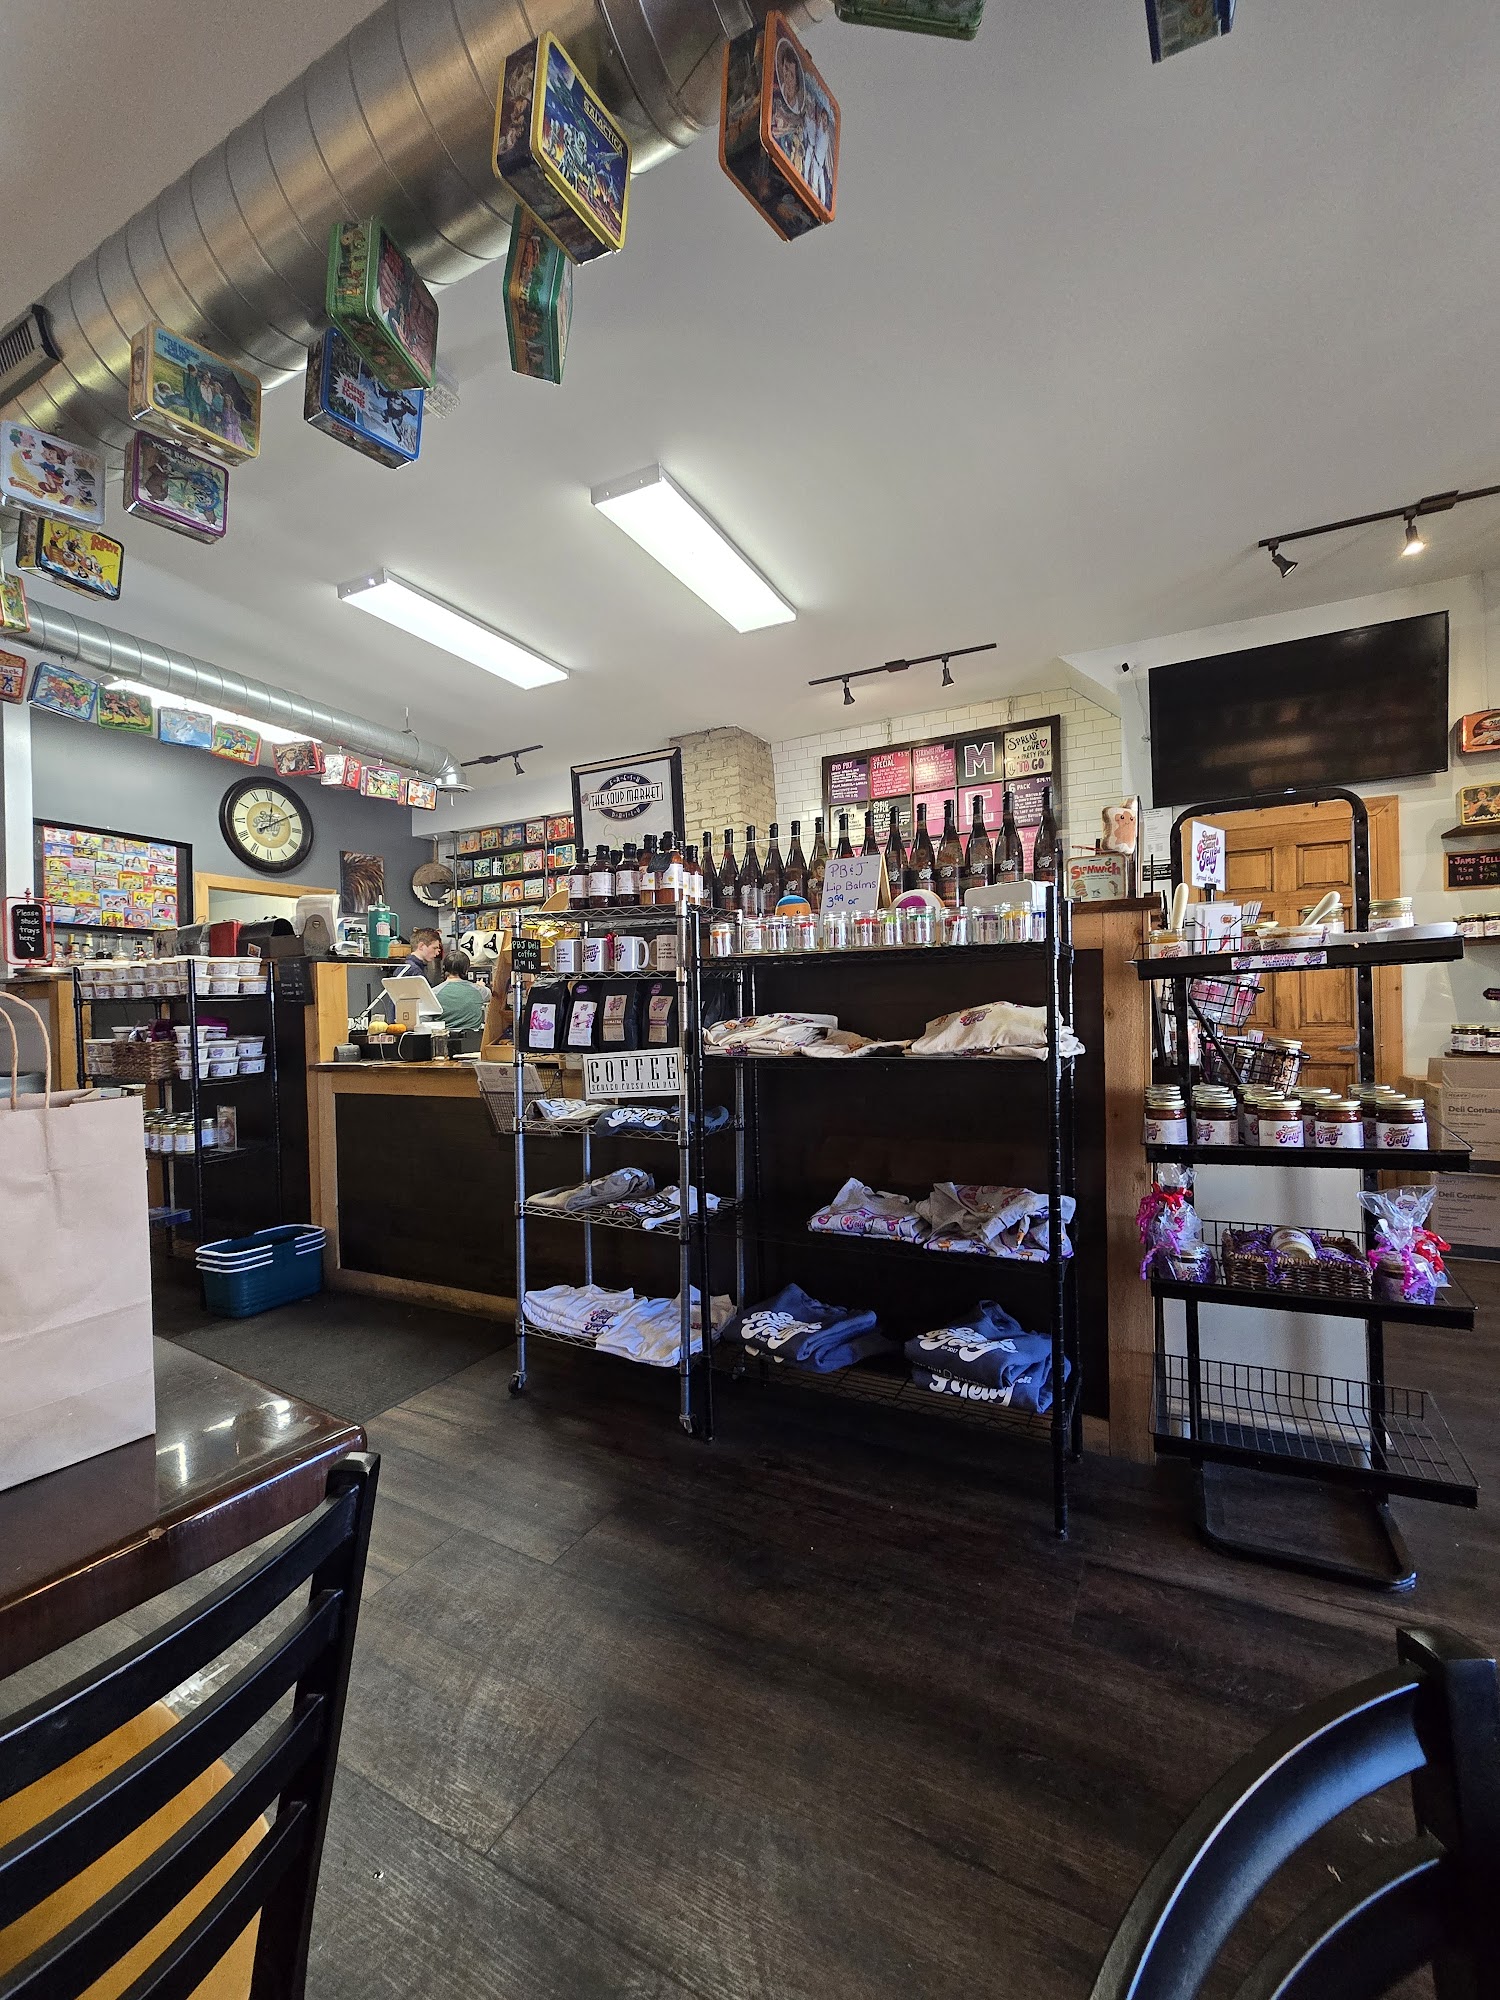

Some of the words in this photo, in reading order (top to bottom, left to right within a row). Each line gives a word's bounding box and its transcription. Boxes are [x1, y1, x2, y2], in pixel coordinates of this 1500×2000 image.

[583, 99, 623, 153] GALACTICA
[343, 378, 366, 399] King
[342, 387, 366, 409] Kong
[151, 440, 172, 455] YOGI
[873, 760, 895, 769] SPECIAL
[1017, 760, 1030, 773] TO
[1031, 758, 1045, 771] GO
[1009, 783, 1016, 794] 6
[1016, 783, 1031, 791] PACK
[591, 795, 605, 807] THE
[606, 791, 625, 804] SOUP
[626, 785, 661, 803] MARKET
[1199, 850, 1217, 874] Jelly
[1455, 857, 1476, 865] JAMS
[826, 881, 842, 894] Lip
[846, 880, 877, 891] Balms
[848, 897, 859, 905] or
[19, 925, 40, 936] trays
[18, 934, 36, 942] here
[512, 940, 526, 949] PBJ
[528, 941, 539, 950] Deli
[517, 950, 538, 958] coffee
[591, 1056, 677, 1083] COFFEE
[592, 1084, 618, 1092] SERVED
[647, 1081, 660, 1089] ALL
[1448, 1105, 1465, 1113] Deli
[1279, 1132, 1300, 1144] Jelly
[1318, 1132, 1339, 1145] Jelly
[1387, 1134, 1411, 1147] Jelly
